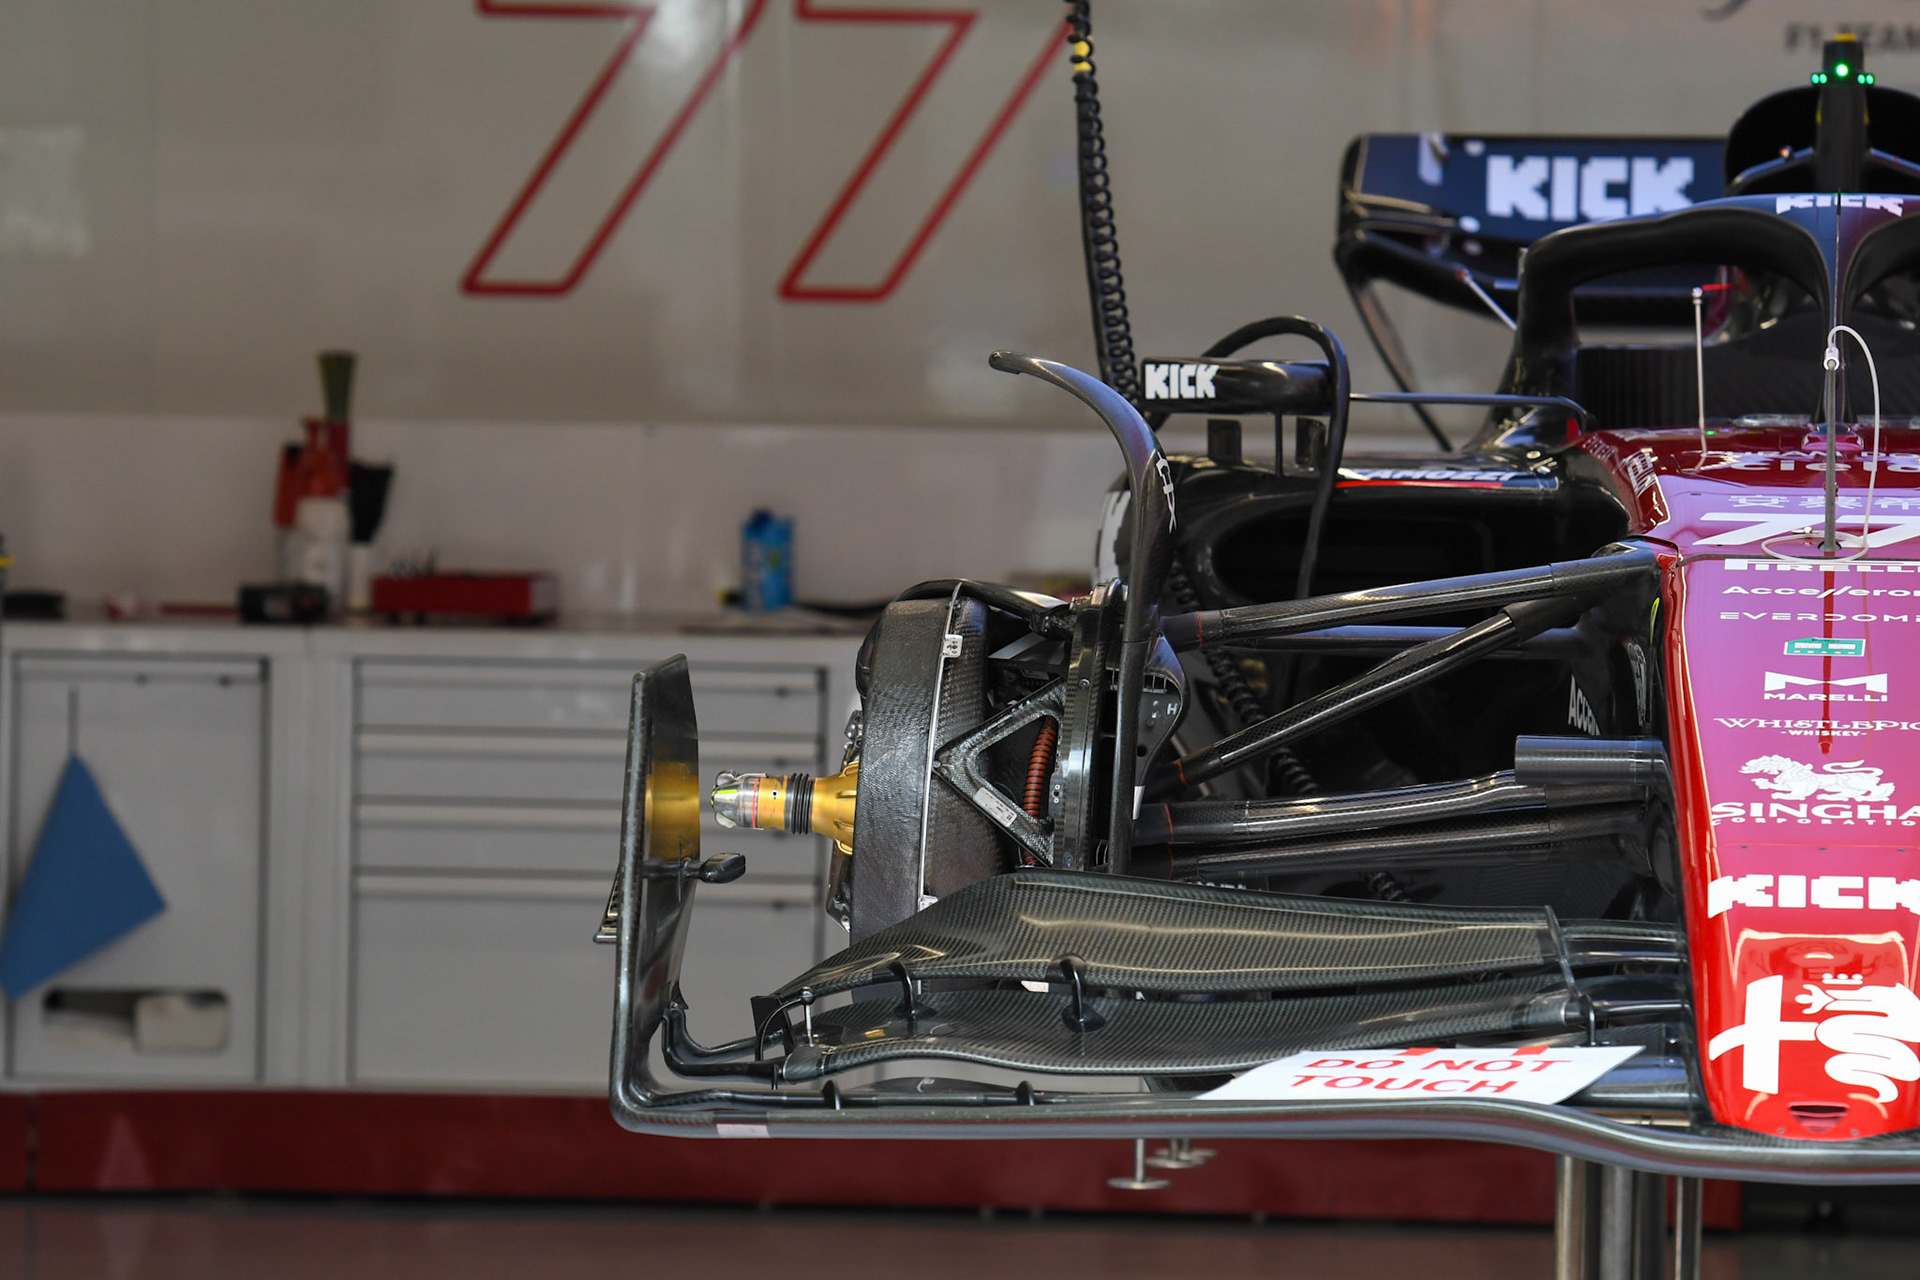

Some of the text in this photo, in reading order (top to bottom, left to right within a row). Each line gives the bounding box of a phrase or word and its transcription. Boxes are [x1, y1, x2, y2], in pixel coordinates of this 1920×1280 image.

[1486, 155, 1695, 221] KICK
[1776, 195, 1904, 217] KICK
[1145, 363, 1219, 399] KICK
[1724, 558, 1920, 573] PIRELL
[1722, 585, 1920, 598] Accellero
[1719, 611, 1920, 622] EVERDOM
[1763, 692, 1888, 702] MARELLI
[1710, 802, 1920, 820] SINGHA
[1707, 874, 1920, 919] KICK
[1304, 1058, 1573, 1072] DO NOT
[1290, 1075, 1519, 1094] TOUCH
